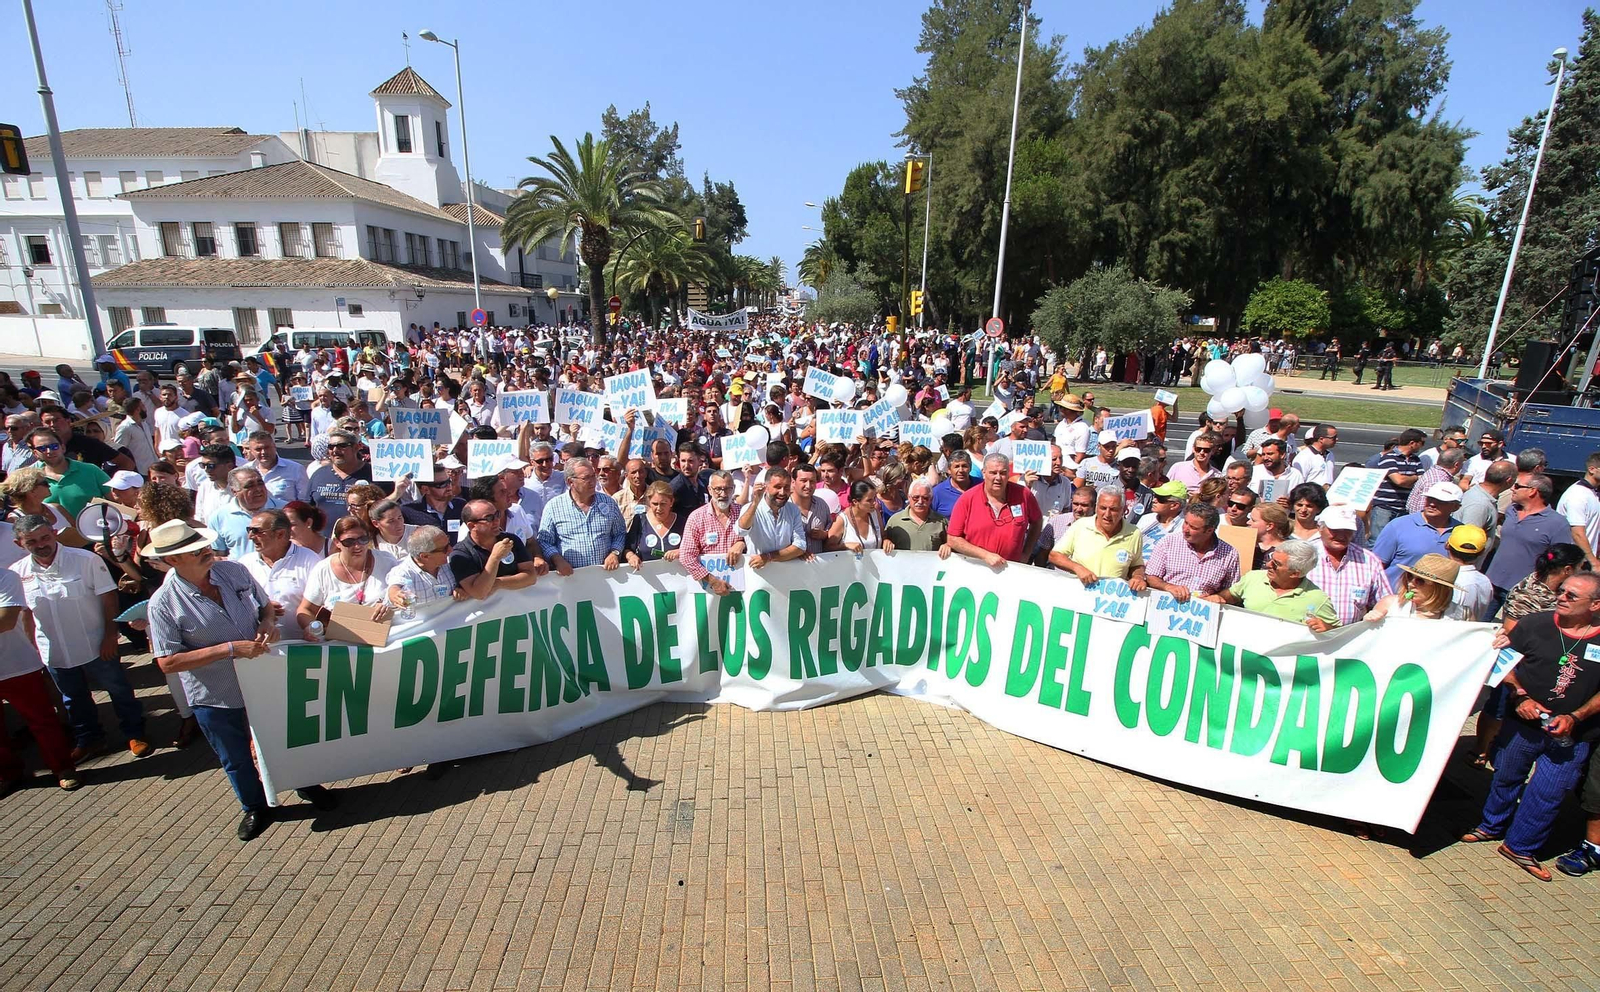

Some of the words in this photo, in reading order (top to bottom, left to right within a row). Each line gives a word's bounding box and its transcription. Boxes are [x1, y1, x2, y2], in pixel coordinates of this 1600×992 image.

[691, 316, 722, 327] AGUA
[610, 372, 648, 394] ¡¡AGUA
[502, 394, 542, 409] ¡¡AGUA
[559, 391, 599, 409] ¡¡AGUA
[621, 390, 647, 409] YA!!
[396, 411, 442, 425] ¡¡AGUA
[512, 409, 539, 423] YA!!
[568, 407, 594, 424] YA!!
[820, 412, 857, 425] ¡¡AGUA
[1107, 416, 1142, 429] ¡¡AGUA
[829, 426, 854, 440] YA!!
[376, 443, 424, 459] ¡¡AGUA
[1016, 443, 1046, 457] ¡¡AGUA
[1022, 459, 1043, 472] YA!!
[1093, 597, 1130, 618] YA!!
[1167, 614, 1203, 637] YA!!
[287, 645, 374, 748] EN
[394, 600, 611, 729] DEFENSA
[618, 591, 683, 691] DE
[694, 589, 771, 680] LOS
[788, 571, 999, 688] REGADÍOS
[1004, 599, 1093, 717] DEL
[1113, 622, 1432, 784] CONDADO
